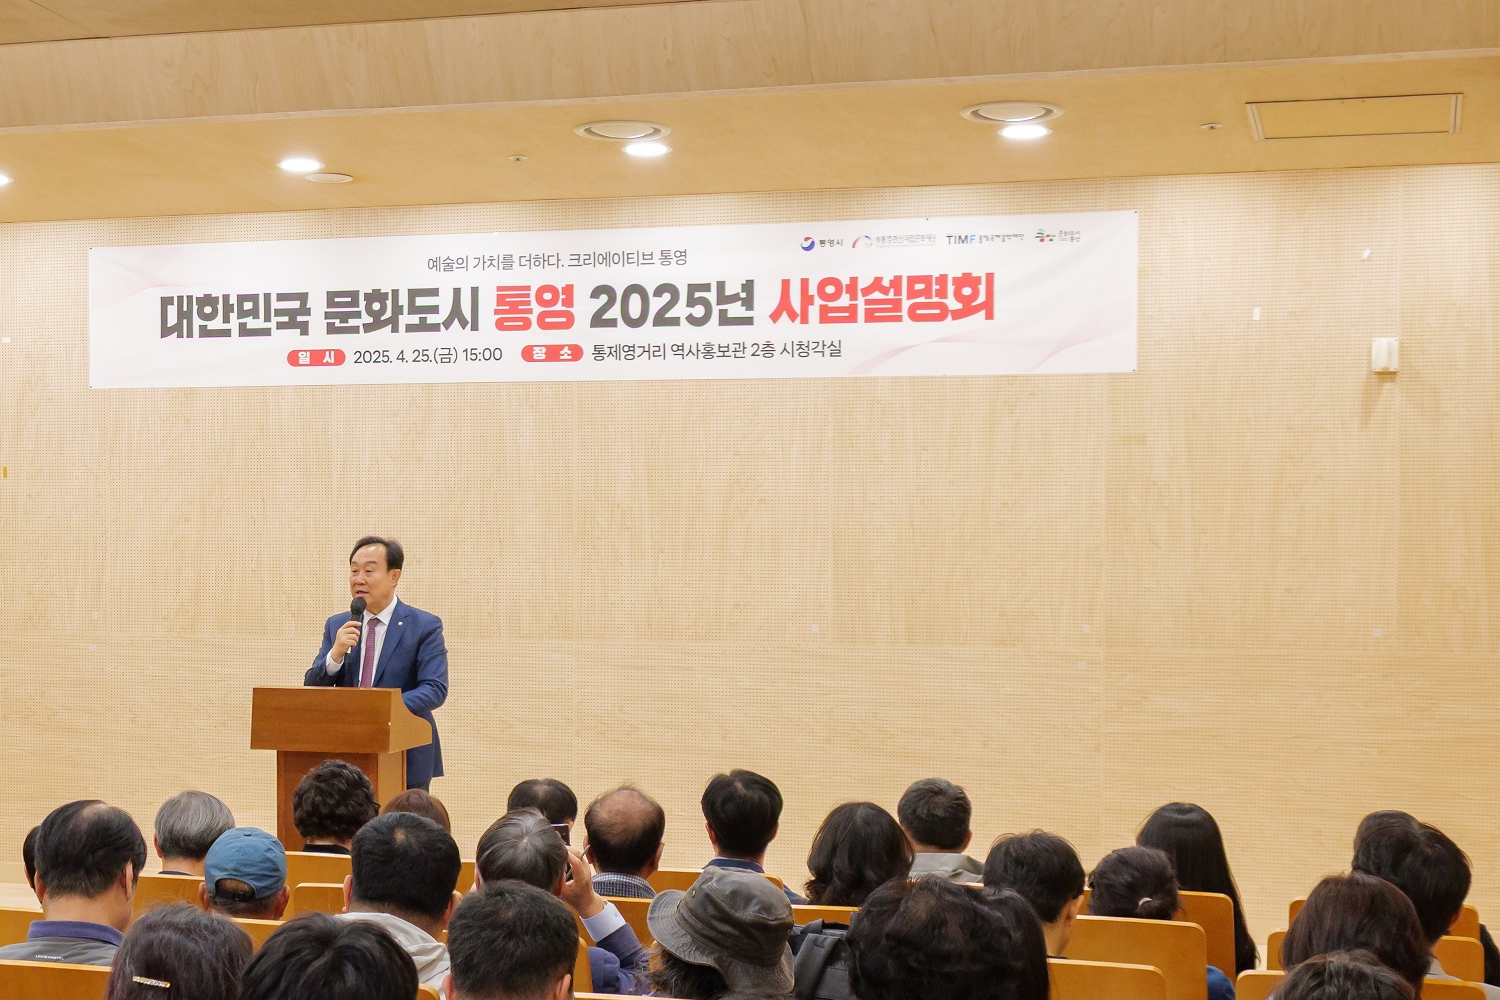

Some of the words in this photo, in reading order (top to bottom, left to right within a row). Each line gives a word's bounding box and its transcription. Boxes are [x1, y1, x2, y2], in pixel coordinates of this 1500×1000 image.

[818, 238, 843, 248] 통영시
[946, 234, 976, 245] TIMF
[427, 256, 469, 273] 예술의
[473, 254, 515, 271] 가치를
[518, 253, 565, 270] 더하다.
[567, 250, 655, 268] 크리에이티브
[658, 249, 688, 267] 통영
[160, 291, 312, 339] 대한민국
[324, 286, 480, 336] 문화도시
[494, 283, 575, 332] 통영
[589, 278, 755, 329] 2025년
[768, 271, 995, 325] 사업설명회
[353, 349, 393, 364] 2025.
[395, 349, 409, 363] 4.
[411, 346, 459, 365] 25.(금)
[462, 347, 503, 362] 15:00
[591, 343, 667, 362] 통제영거리
[670, 341, 747, 360] 역사홍보관
[750, 340, 776, 359] 2층
[779, 339, 842, 358] 시청각실
